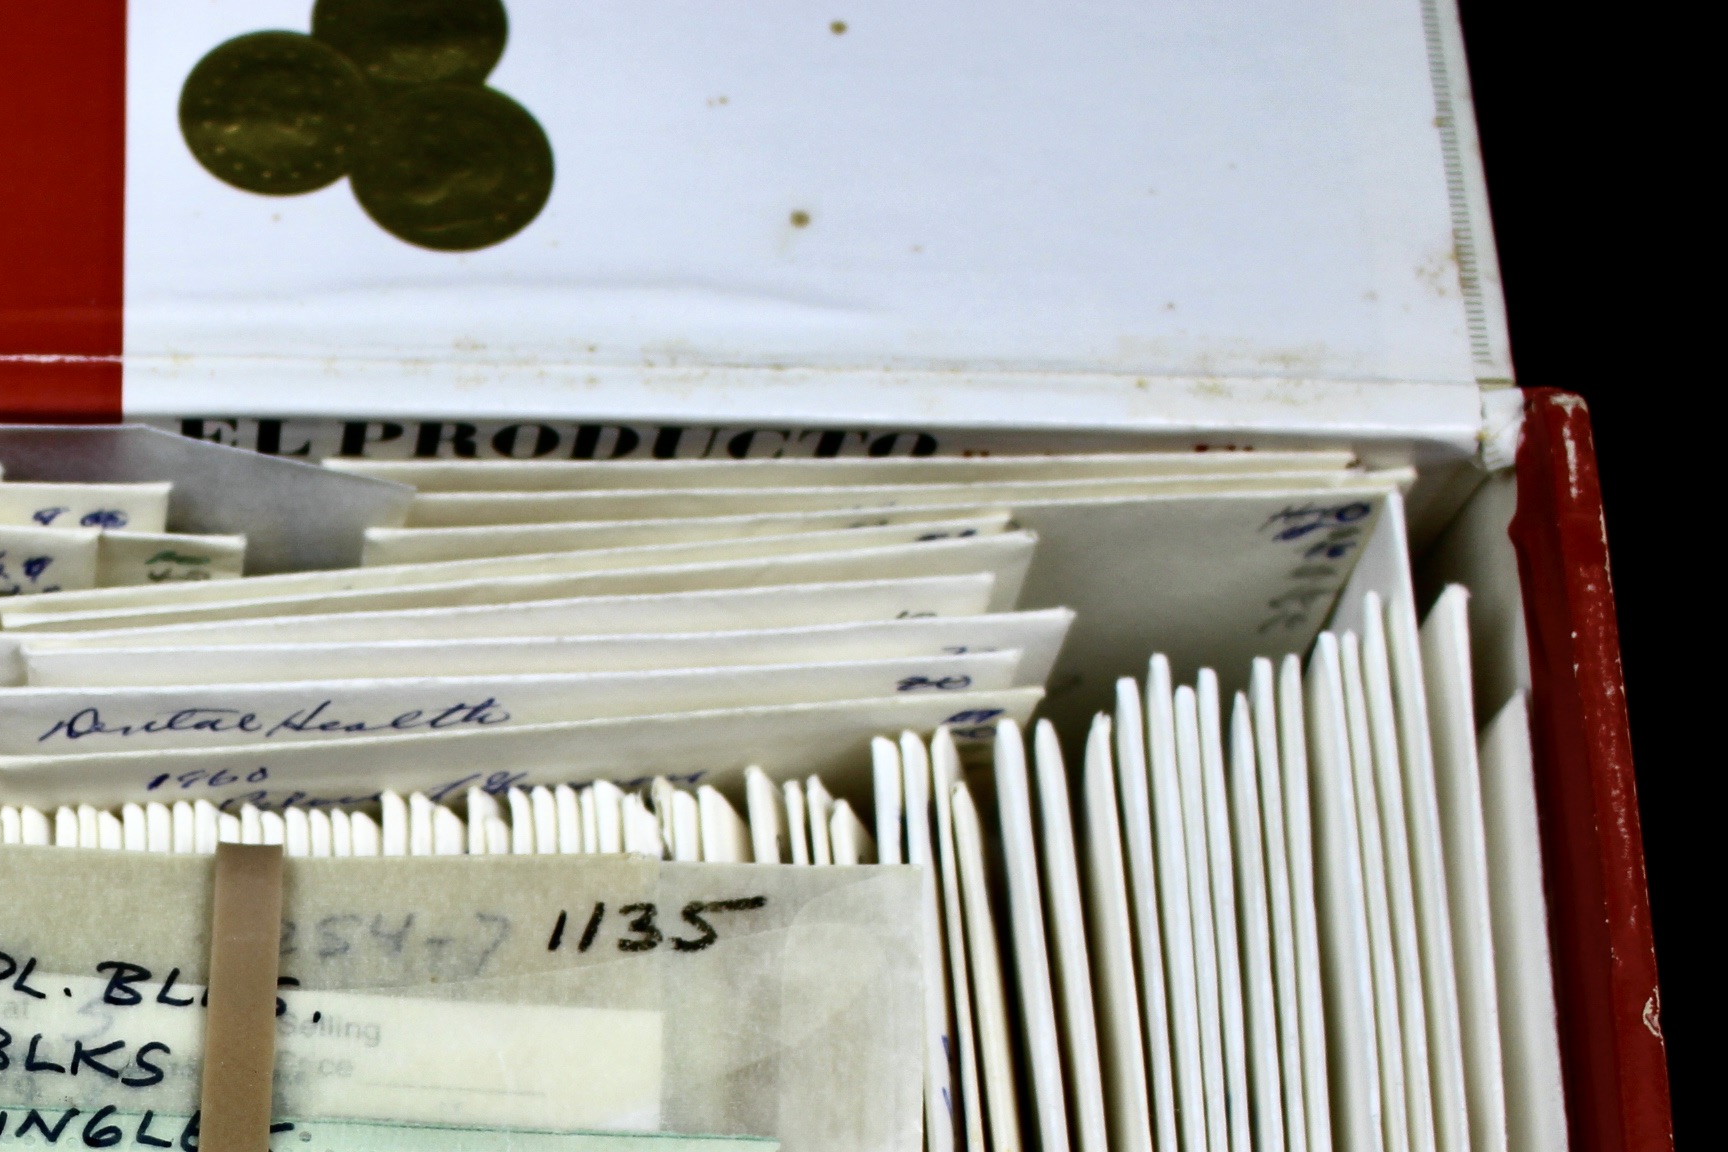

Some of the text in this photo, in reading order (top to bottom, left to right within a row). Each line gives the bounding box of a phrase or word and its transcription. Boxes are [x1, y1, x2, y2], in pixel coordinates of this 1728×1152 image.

[175, 419, 938, 460] EL PRODUCTO
[547, 894, 769, 953] 1135
